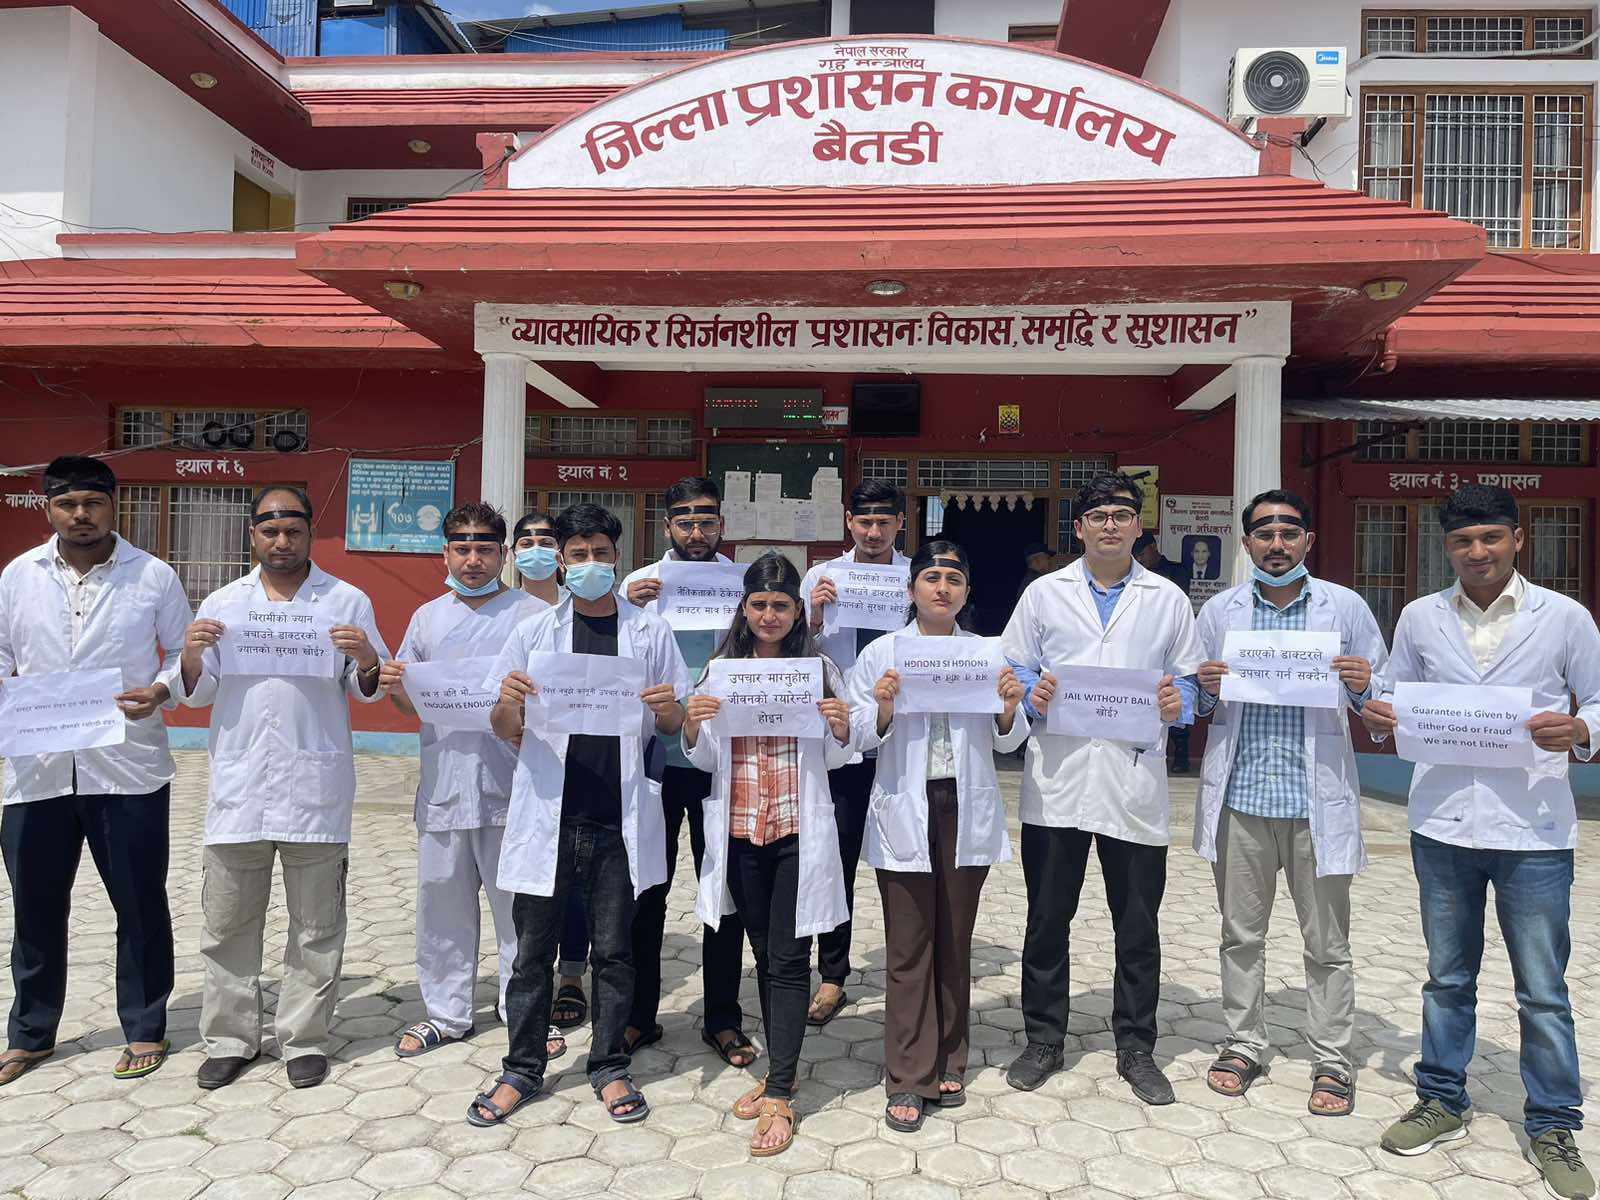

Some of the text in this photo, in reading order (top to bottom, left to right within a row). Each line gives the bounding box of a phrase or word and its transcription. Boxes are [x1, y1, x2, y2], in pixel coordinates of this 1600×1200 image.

[833, 43, 910, 58] नेपाल सरकार
[818, 59, 850, 71] गृह
[580, 71, 1178, 175] जिल्ला प्रशासन कार्यालय
[812, 119, 944, 166] बैतडी
[646, 319, 659, 349] र
[666, 312, 799, 349] सिर्जनशील
[927, 311, 1018, 349] विकास,
[1021, 308, 1099, 352] समृद्धि
[1100, 313, 1121, 345] र
[233, 459, 245, 477] ६
[618, 465, 628, 481] २
[248, 611, 289, 624] बिरामीको
[242, 628, 318, 640] बचाउने डाक्टरको
[236, 643, 271, 654] ज्यानको
[275, 645, 298, 657] सुरक्षा
[1239, 647, 1323, 661] डराएको डाक्टरले
[904, 660, 989, 668] ENOUGH IS ENOUGH
[727, 669, 811, 688] उपचार माग्नुहोस
[1239, 667, 1328, 682] उपचार गर्न सक्दैन
[727, 690, 813, 704] जीवनको ग्यारेन्टी
[1063, 692, 1152, 706] JAIL WITHOUT BAIL
[464, 699, 498, 710] ENOUGH
[757, 711, 783, 725] होइन
[1411, 706, 1518, 722] Guarantee is Given by
[1417, 721, 1512, 735] Either God or Fraud
[1423, 737, 1440, 745] We
[1442, 738, 1458, 746] are
[1460, 739, 1478, 748] not
